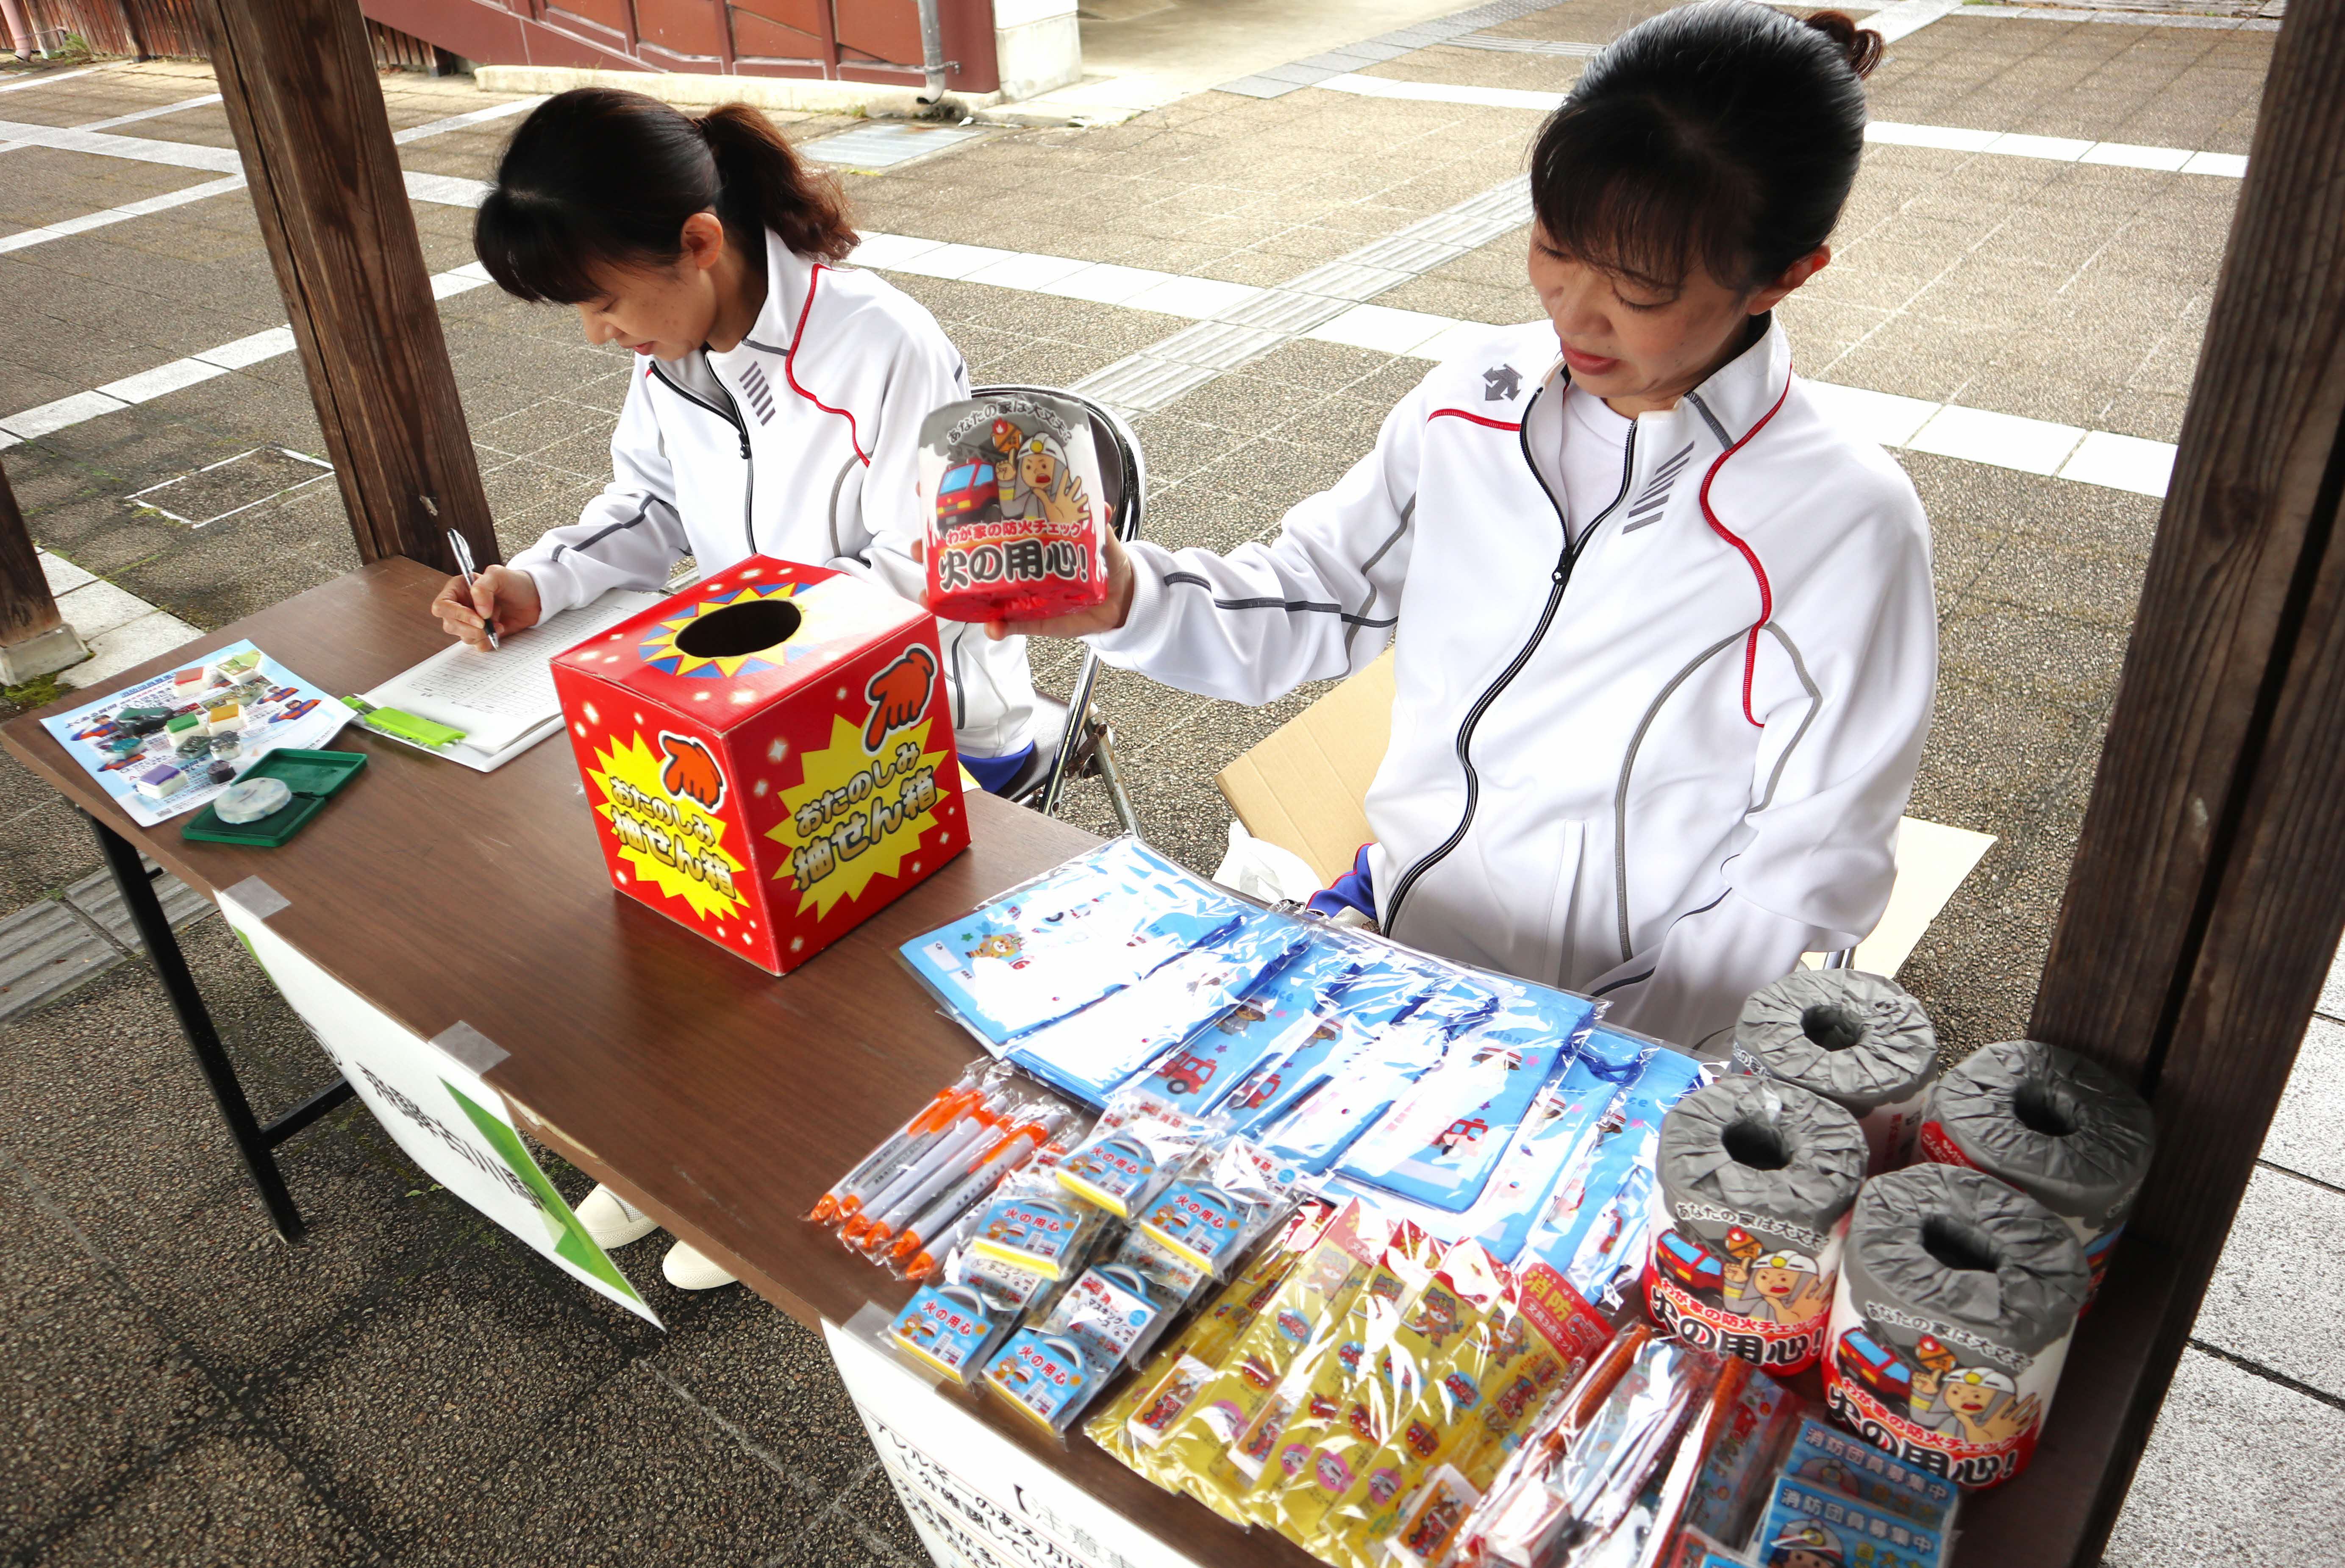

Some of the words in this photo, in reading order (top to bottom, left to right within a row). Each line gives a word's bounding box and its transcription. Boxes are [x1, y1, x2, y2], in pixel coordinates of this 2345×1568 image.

[947, 400, 1072, 445] あなたの家は大丈夫?
[946, 520, 1082, 544] わが家の防火チェック
[939, 538, 1088, 592] 火の用心!
[611, 776, 715, 847] おたのしみ
[795, 742, 920, 837] おたのしみ
[611, 806, 736, 899] 抽せん箱
[792, 768, 936, 892] 抽せん箱
[1089, 1143, 1139, 1175] 火の用心
[1004, 1206, 1061, 1232] 火の用心
[1174, 1193, 1225, 1229] 火の用心
[921, 1301, 972, 1337] 火の用心
[1523, 1271, 1573, 1322] 消防
[1661, 1278, 1822, 1334] わが家の防火チェック
[1526, 1302, 1573, 1353] 文具3点セット
[1651, 1286, 1823, 1366] 火の用心!
[1018, 1345, 1067, 1387] 火の用心
[1841, 1377, 2020, 1453] わが家の防火チェック
